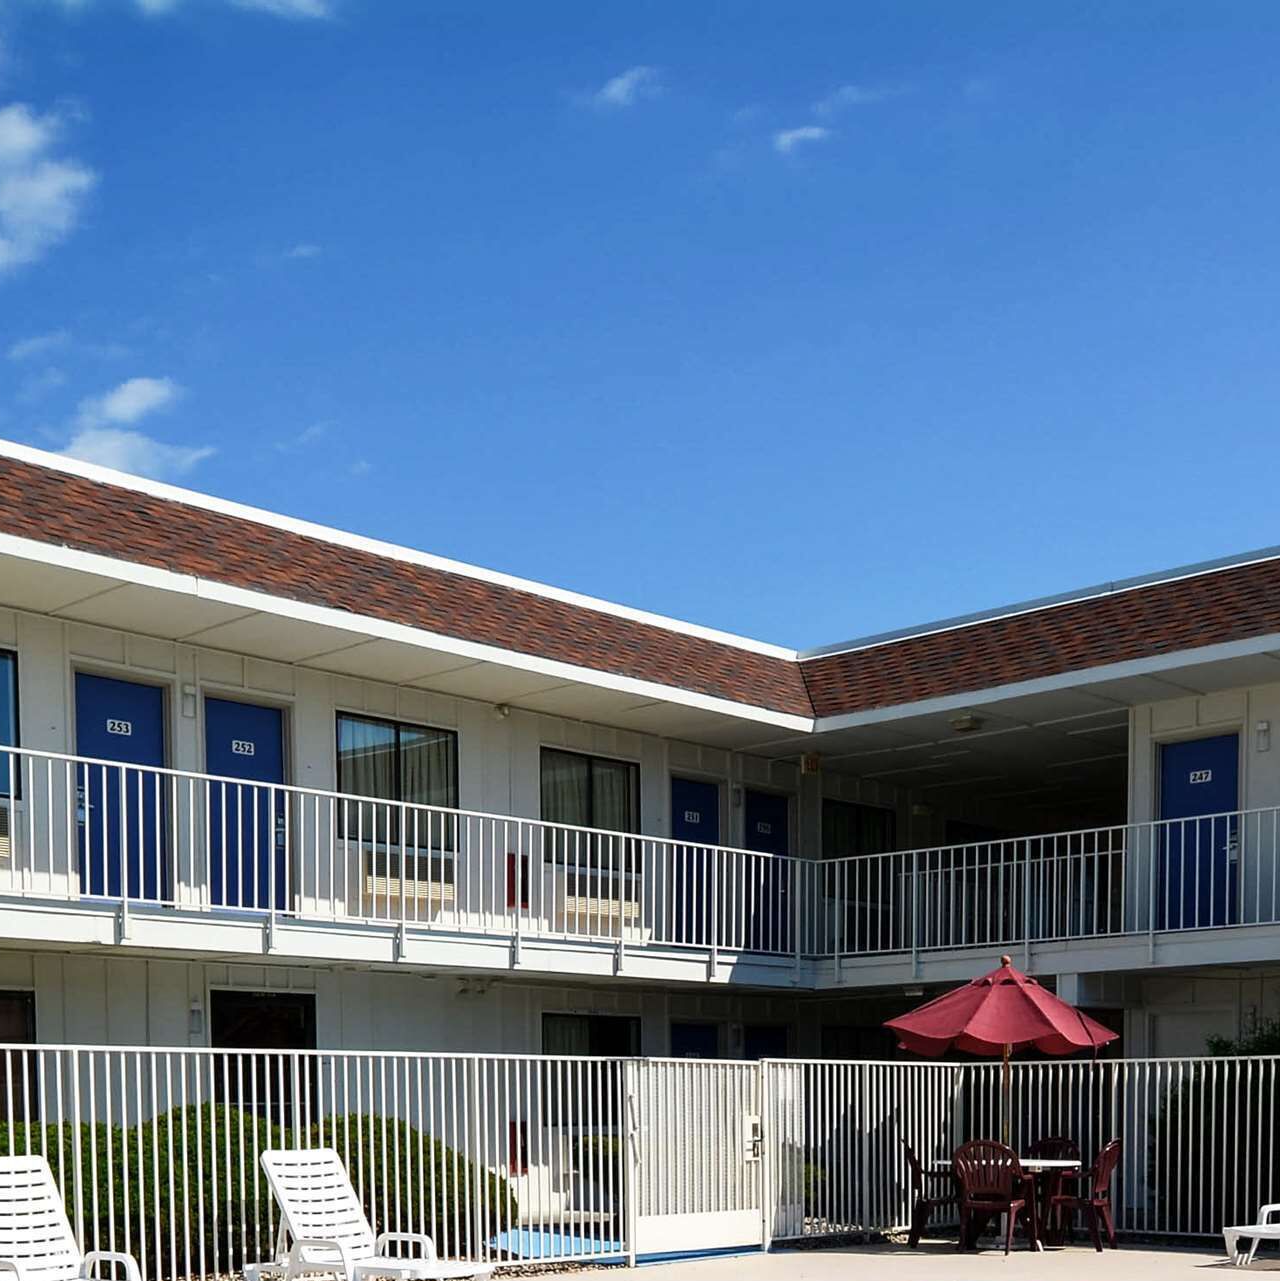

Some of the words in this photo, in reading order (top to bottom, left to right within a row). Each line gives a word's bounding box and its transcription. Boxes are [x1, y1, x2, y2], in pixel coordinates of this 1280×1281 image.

[108, 720, 131, 734] 253
[233, 741, 253, 754] 252
[1191, 771, 1210, 782] 247
